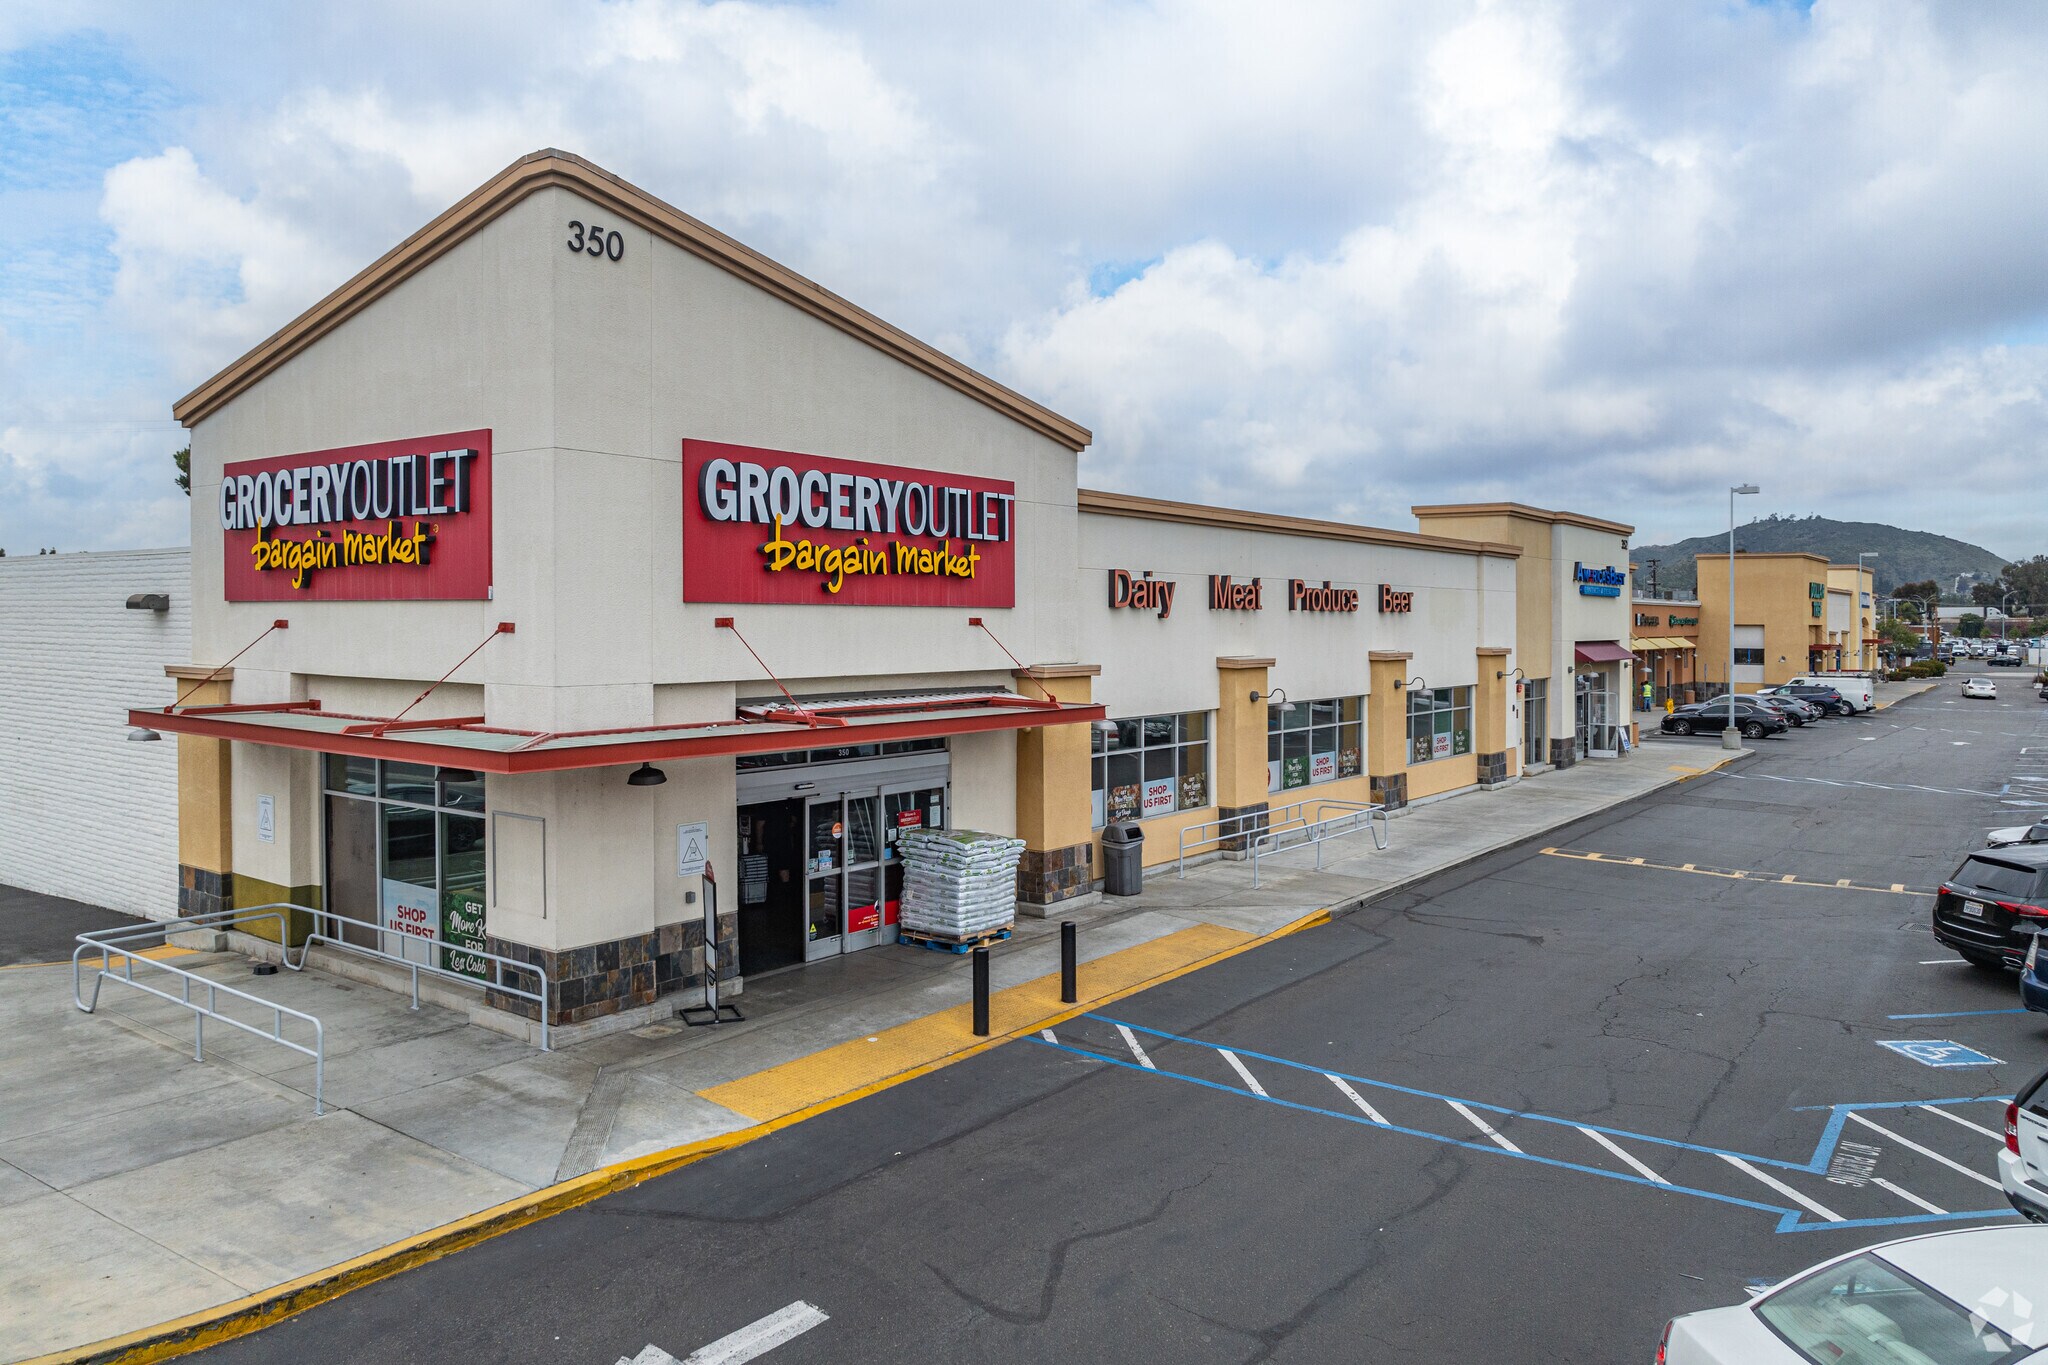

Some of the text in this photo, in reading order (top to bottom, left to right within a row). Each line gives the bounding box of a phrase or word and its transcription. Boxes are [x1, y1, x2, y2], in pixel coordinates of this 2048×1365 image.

[567, 219, 625, 262] 350
[251, 516, 427, 590] bargain market
[764, 513, 981, 594] bargain market
[1111, 568, 1177, 619] Dairy
[1212, 574, 1263, 611] Meat
[1292, 578, 1359, 613] Produce
[1381, 583, 1415, 614] Beer
[838, 748, 850, 757] 350
[1315, 756, 1330, 767] SHOP
[1312, 765, 1333, 777] US FIRST
[1148, 784, 1168, 797] SHOP
[1143, 797, 1153, 809] US
[1153, 794, 1173, 807] FIRST
[397, 904, 427, 924] SHOP
[465, 901, 483, 916] GET
[405, 923, 435, 940] FIRST
[449, 910, 476, 934] More
[465, 939, 484, 953] FOR
